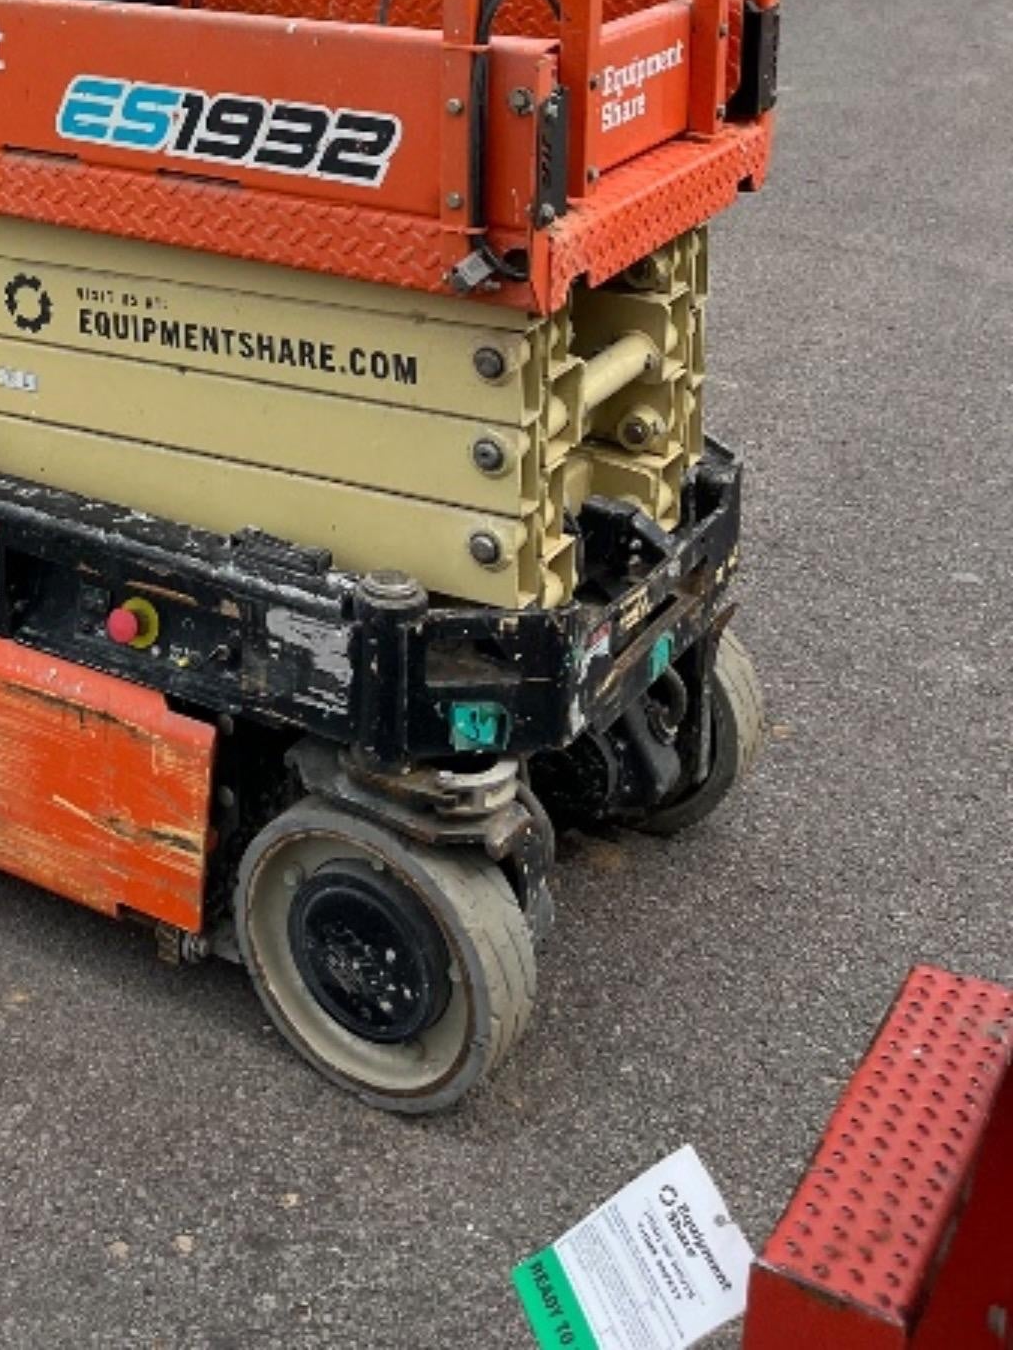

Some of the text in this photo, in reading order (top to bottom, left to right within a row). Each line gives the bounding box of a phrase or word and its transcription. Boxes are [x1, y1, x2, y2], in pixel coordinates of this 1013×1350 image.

[601, 39, 684, 97] Equipment
[55, 75, 402, 188] ES1932
[601, 92, 646, 133] Share
[79, 308, 419, 386] EQUIPMENTSHARE.COM
[529, 1261, 565, 1319] READY
